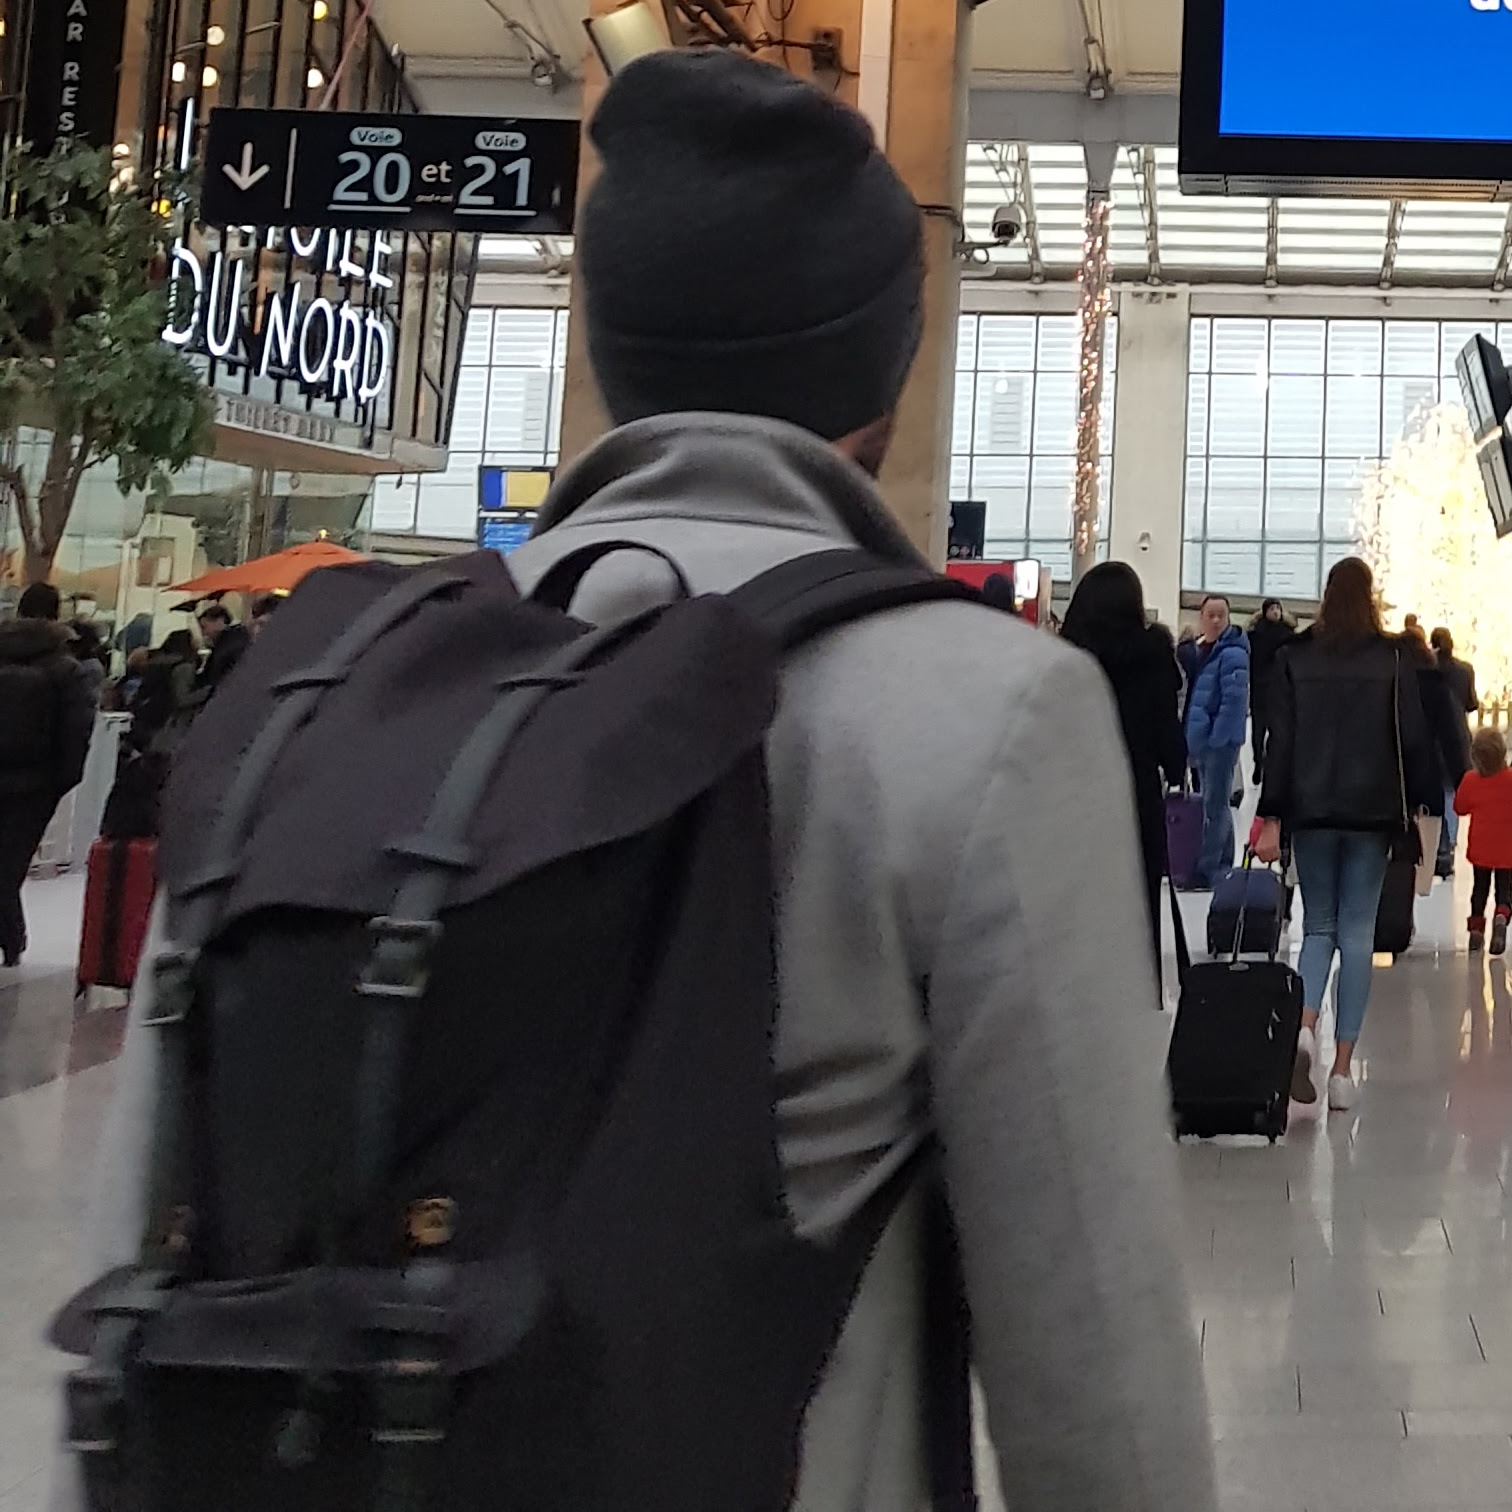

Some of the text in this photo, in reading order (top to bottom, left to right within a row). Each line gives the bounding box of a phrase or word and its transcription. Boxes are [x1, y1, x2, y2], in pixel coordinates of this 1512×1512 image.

[357, 129, 520, 149] Voie Voie
[332, 150, 532, 207] 20 et 21
[162, 238, 243, 356] DU
[259, 281, 391, 404] NORD
